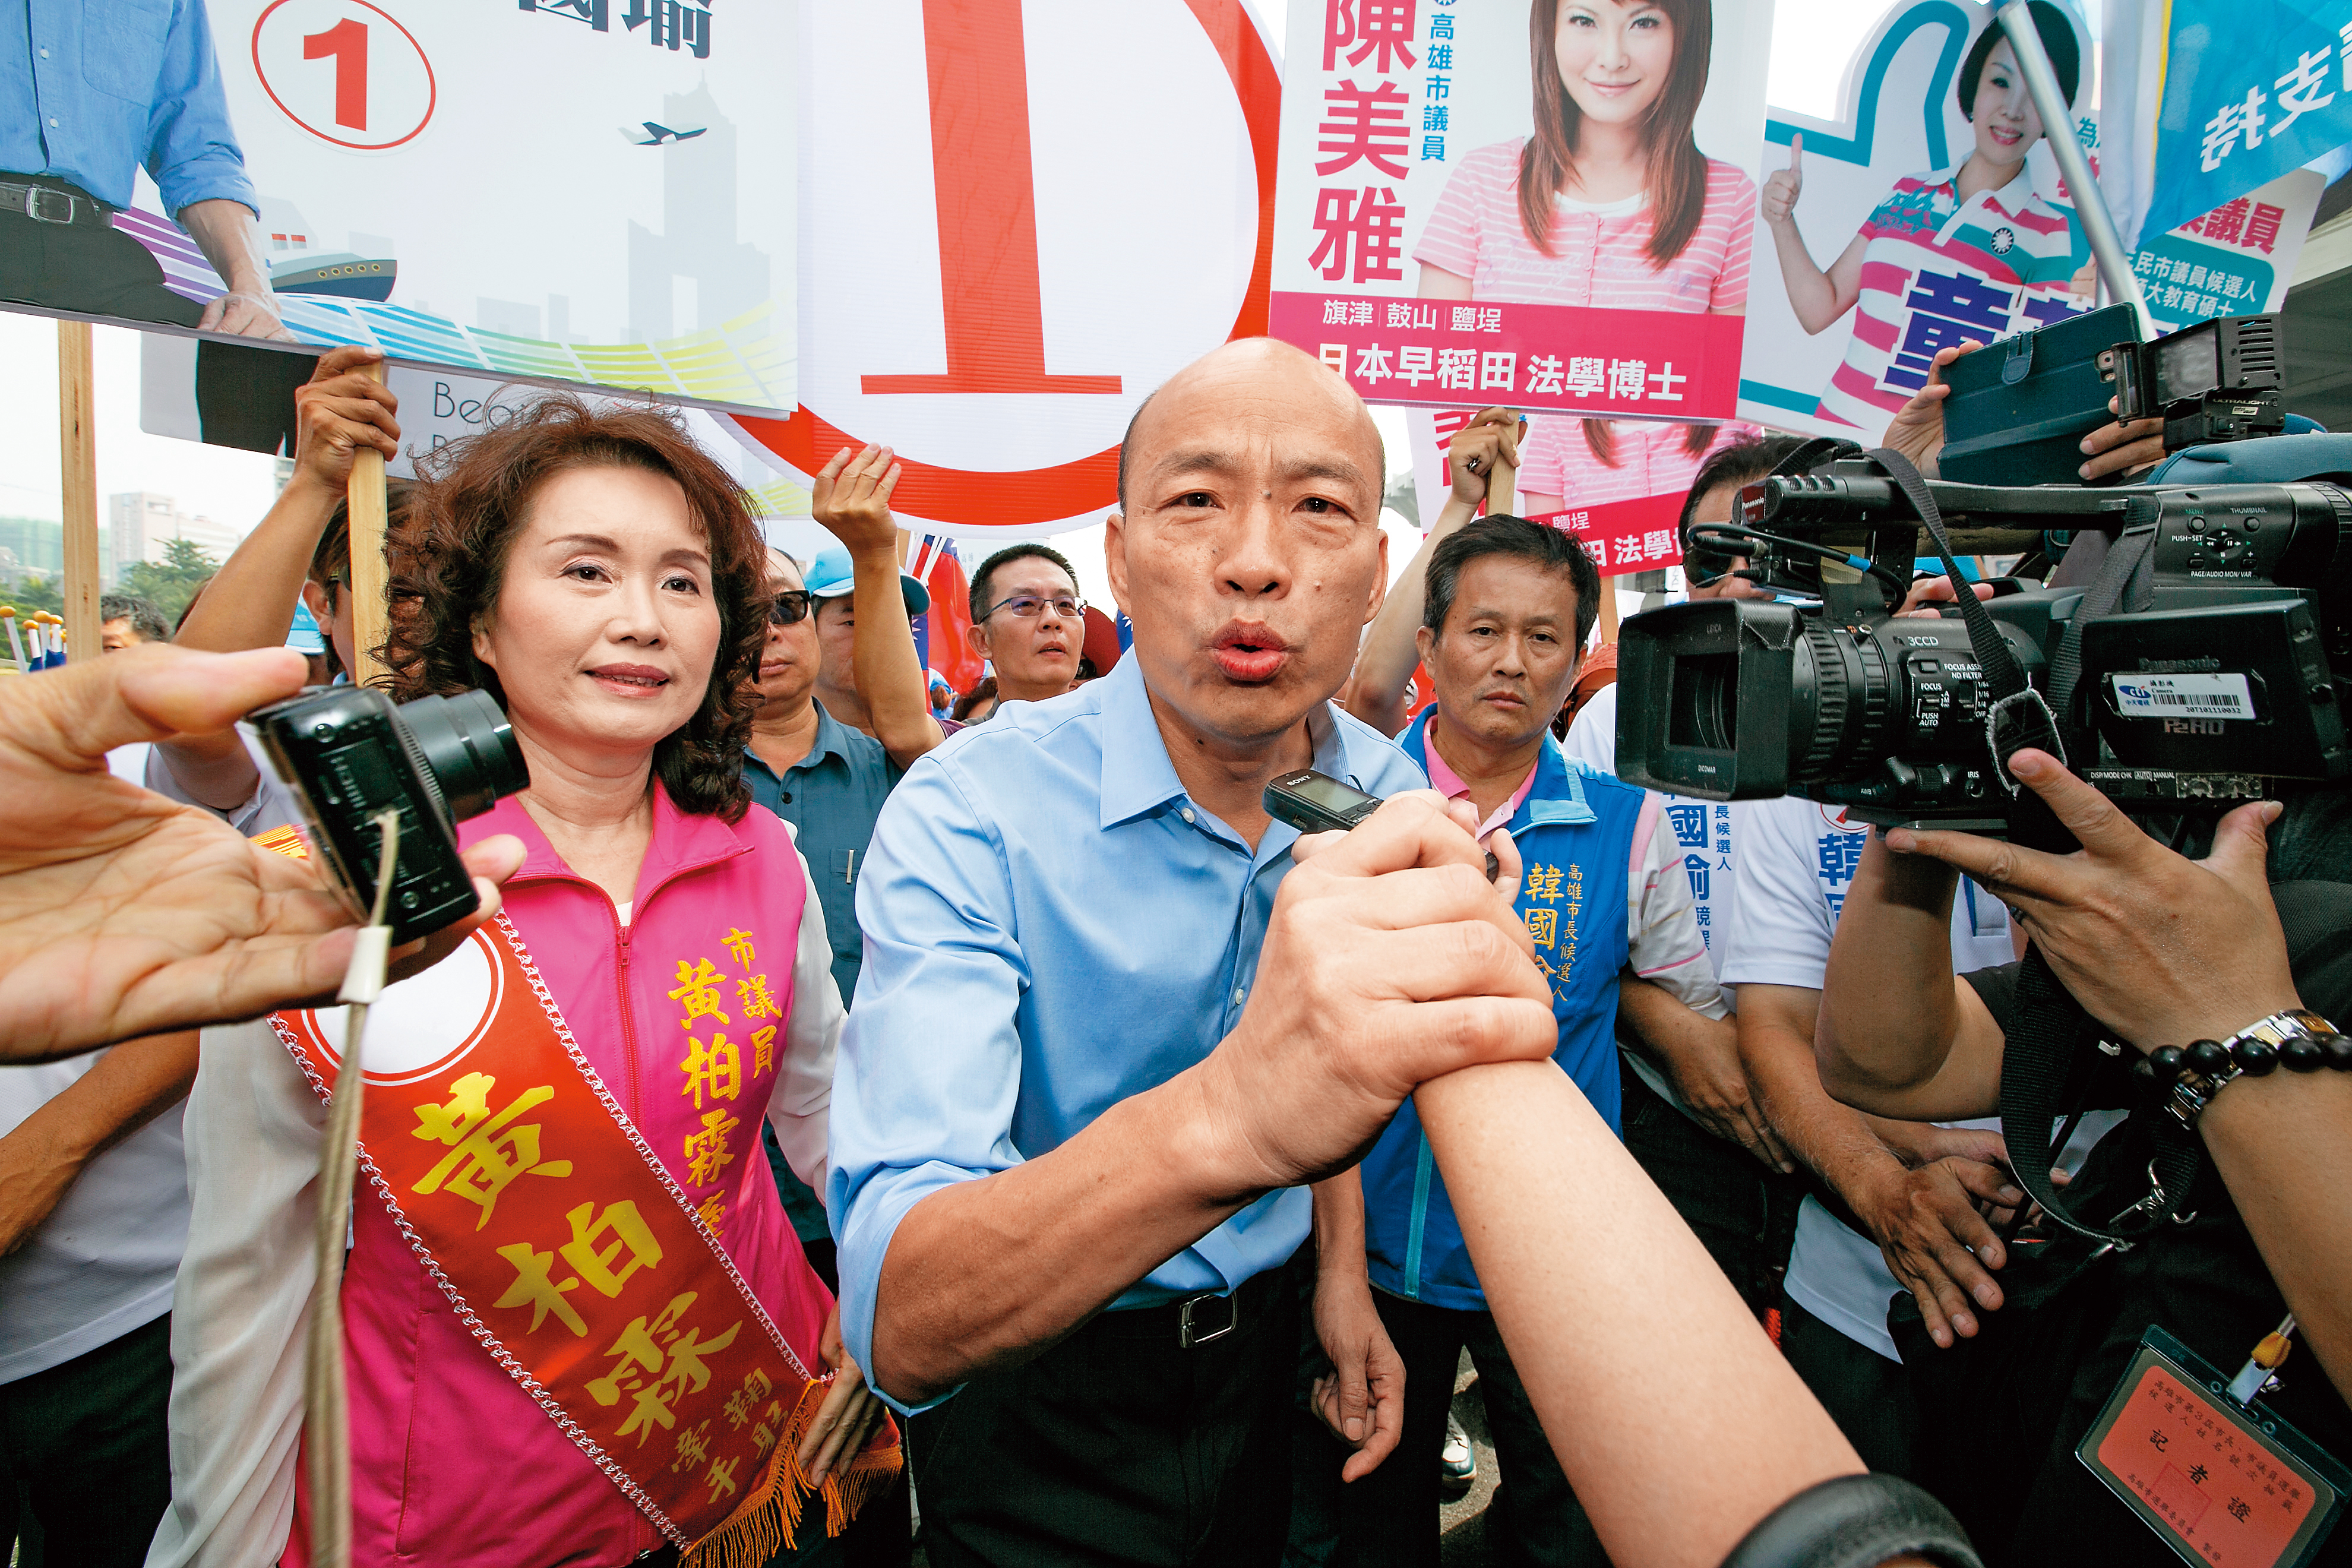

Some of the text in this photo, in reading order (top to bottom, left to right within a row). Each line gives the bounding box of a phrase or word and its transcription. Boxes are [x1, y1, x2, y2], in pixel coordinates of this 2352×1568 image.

[304, 18, 368, 131] 1
[1420, 13, 1455, 163] 高雄市議員
[1308, 0, 1418, 284] 陳美雅
[1323, 300, 1501, 333] 旗津 鼓山 鹽埕
[1318, 343, 1687, 401] 日本早稻田 法學博士
[1742, 497, 1764, 510] Panasonic
[1907, 636, 1939, 647] 3CCD
[2139, 657, 2221, 672] Panasonic
[1951, 672, 1983, 680] ND FILTER
[1286, 774, 1311, 786] SONY
[1698, 764, 1716, 774] DICOMAR
[1553, 863, 1583, 1001] 高雄市長候選人
[720, 927, 782, 1079] 市議員
[411, 1071, 743, 1449] 黃柏霖
[2150, 1429, 2251, 1523] 記者證
